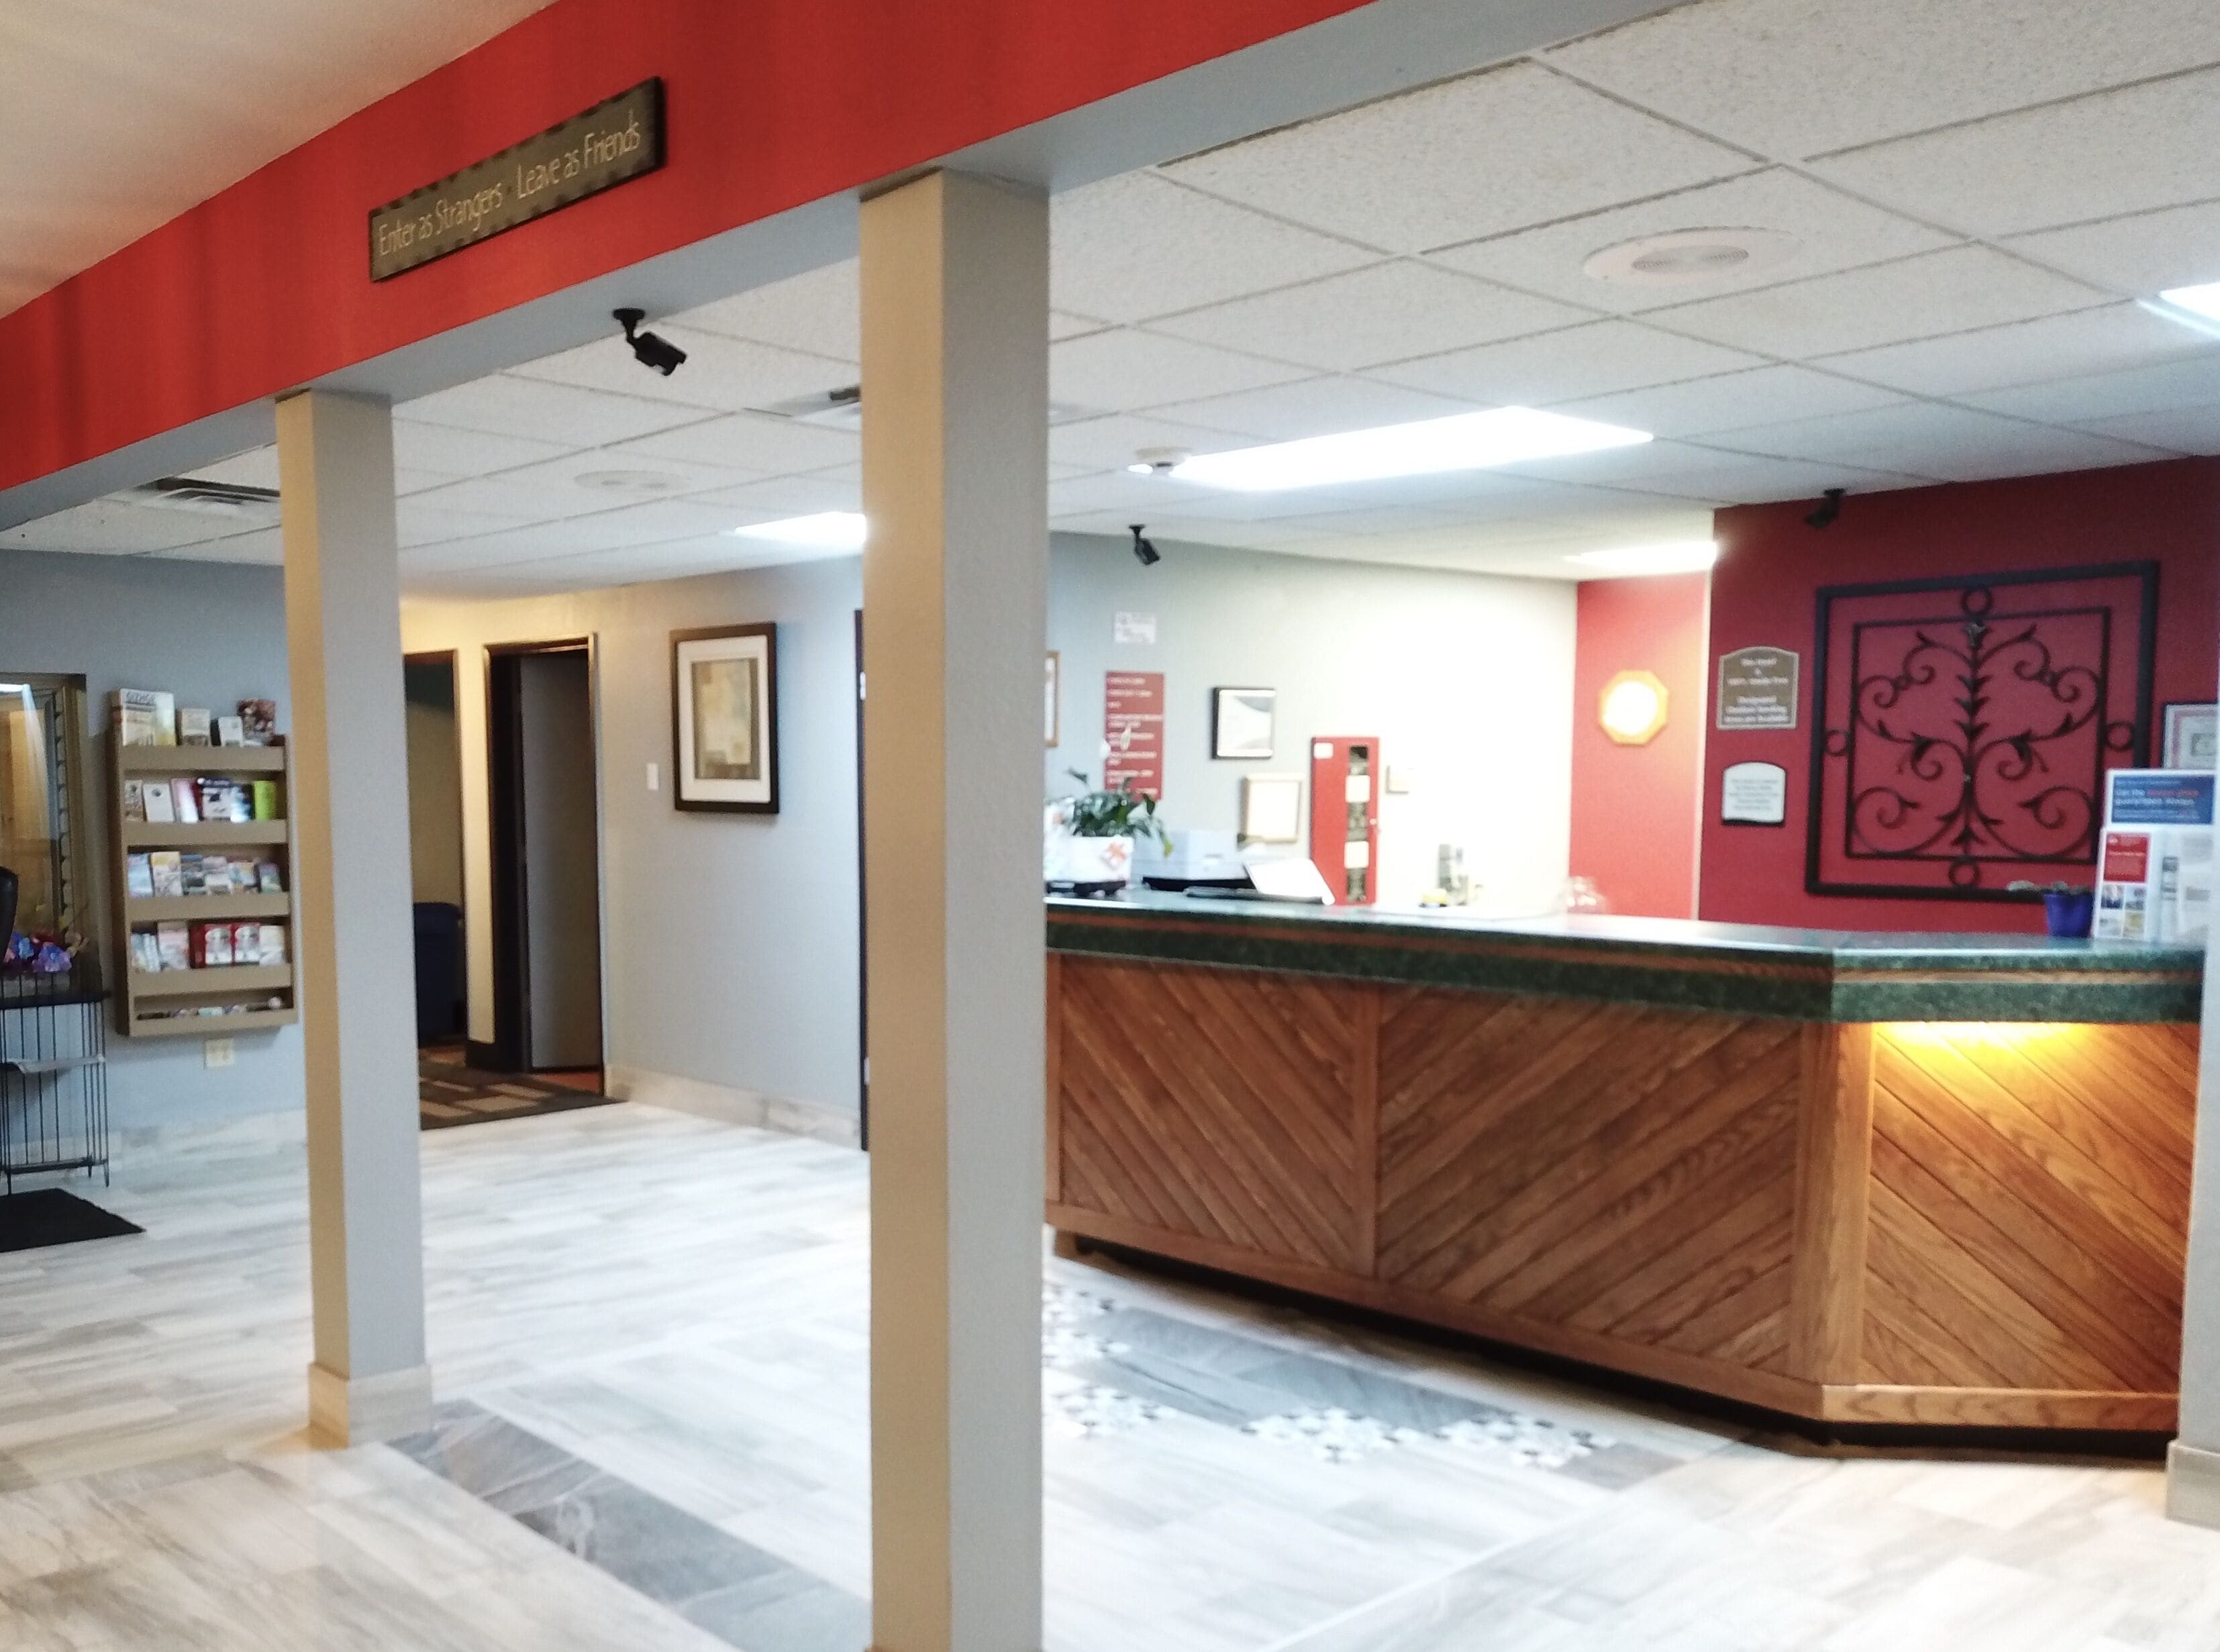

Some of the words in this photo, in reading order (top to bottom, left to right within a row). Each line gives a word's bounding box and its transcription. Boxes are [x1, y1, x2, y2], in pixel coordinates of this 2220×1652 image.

[379, 219, 417, 256] Enter
[419, 214, 434, 240] as
[435, 183, 503, 232] Strangers
[517, 162, 562, 199] Leave
[564, 150, 581, 179] as
[583, 108, 642, 169] Friends
